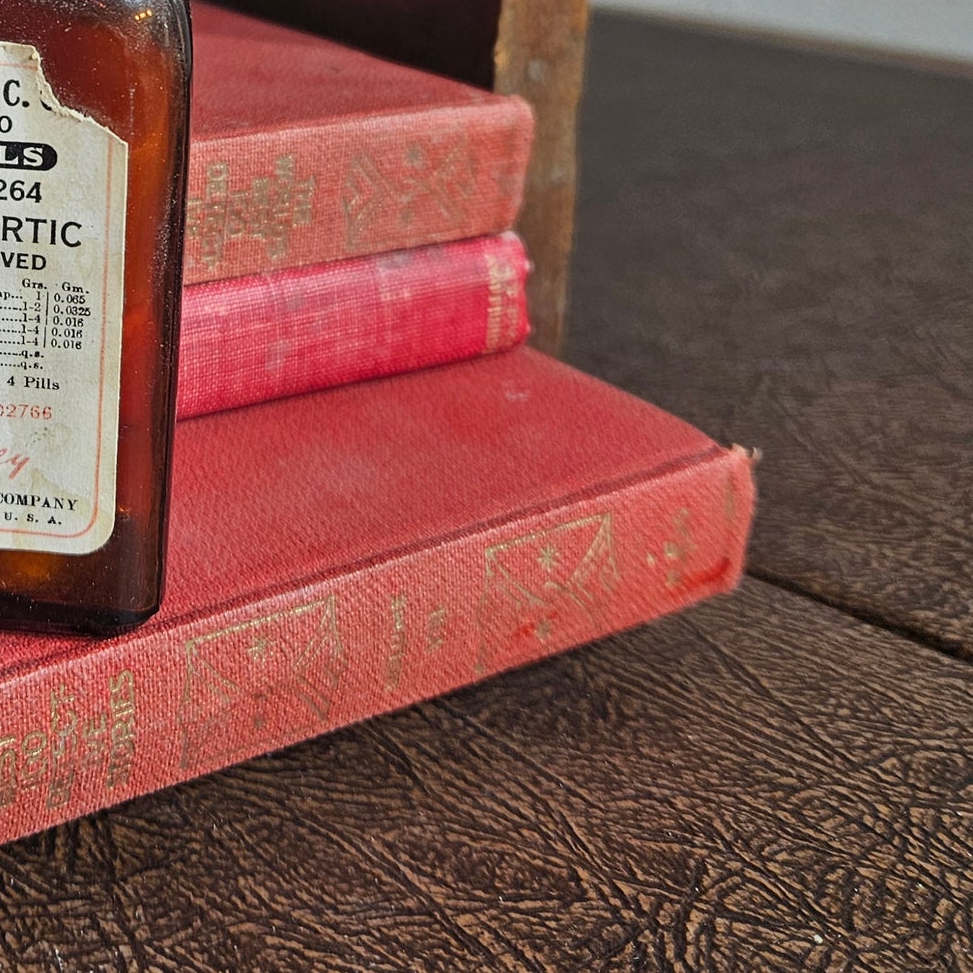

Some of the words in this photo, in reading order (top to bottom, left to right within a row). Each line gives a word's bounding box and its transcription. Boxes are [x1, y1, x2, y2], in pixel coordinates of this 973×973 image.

[2, 80, 30, 108] C.
[61, 282, 89, 294] Gm.
[53, 293, 86, 304] 0.065
[7, 376, 15, 386] 4
[24, 376, 60, 390] Pills
